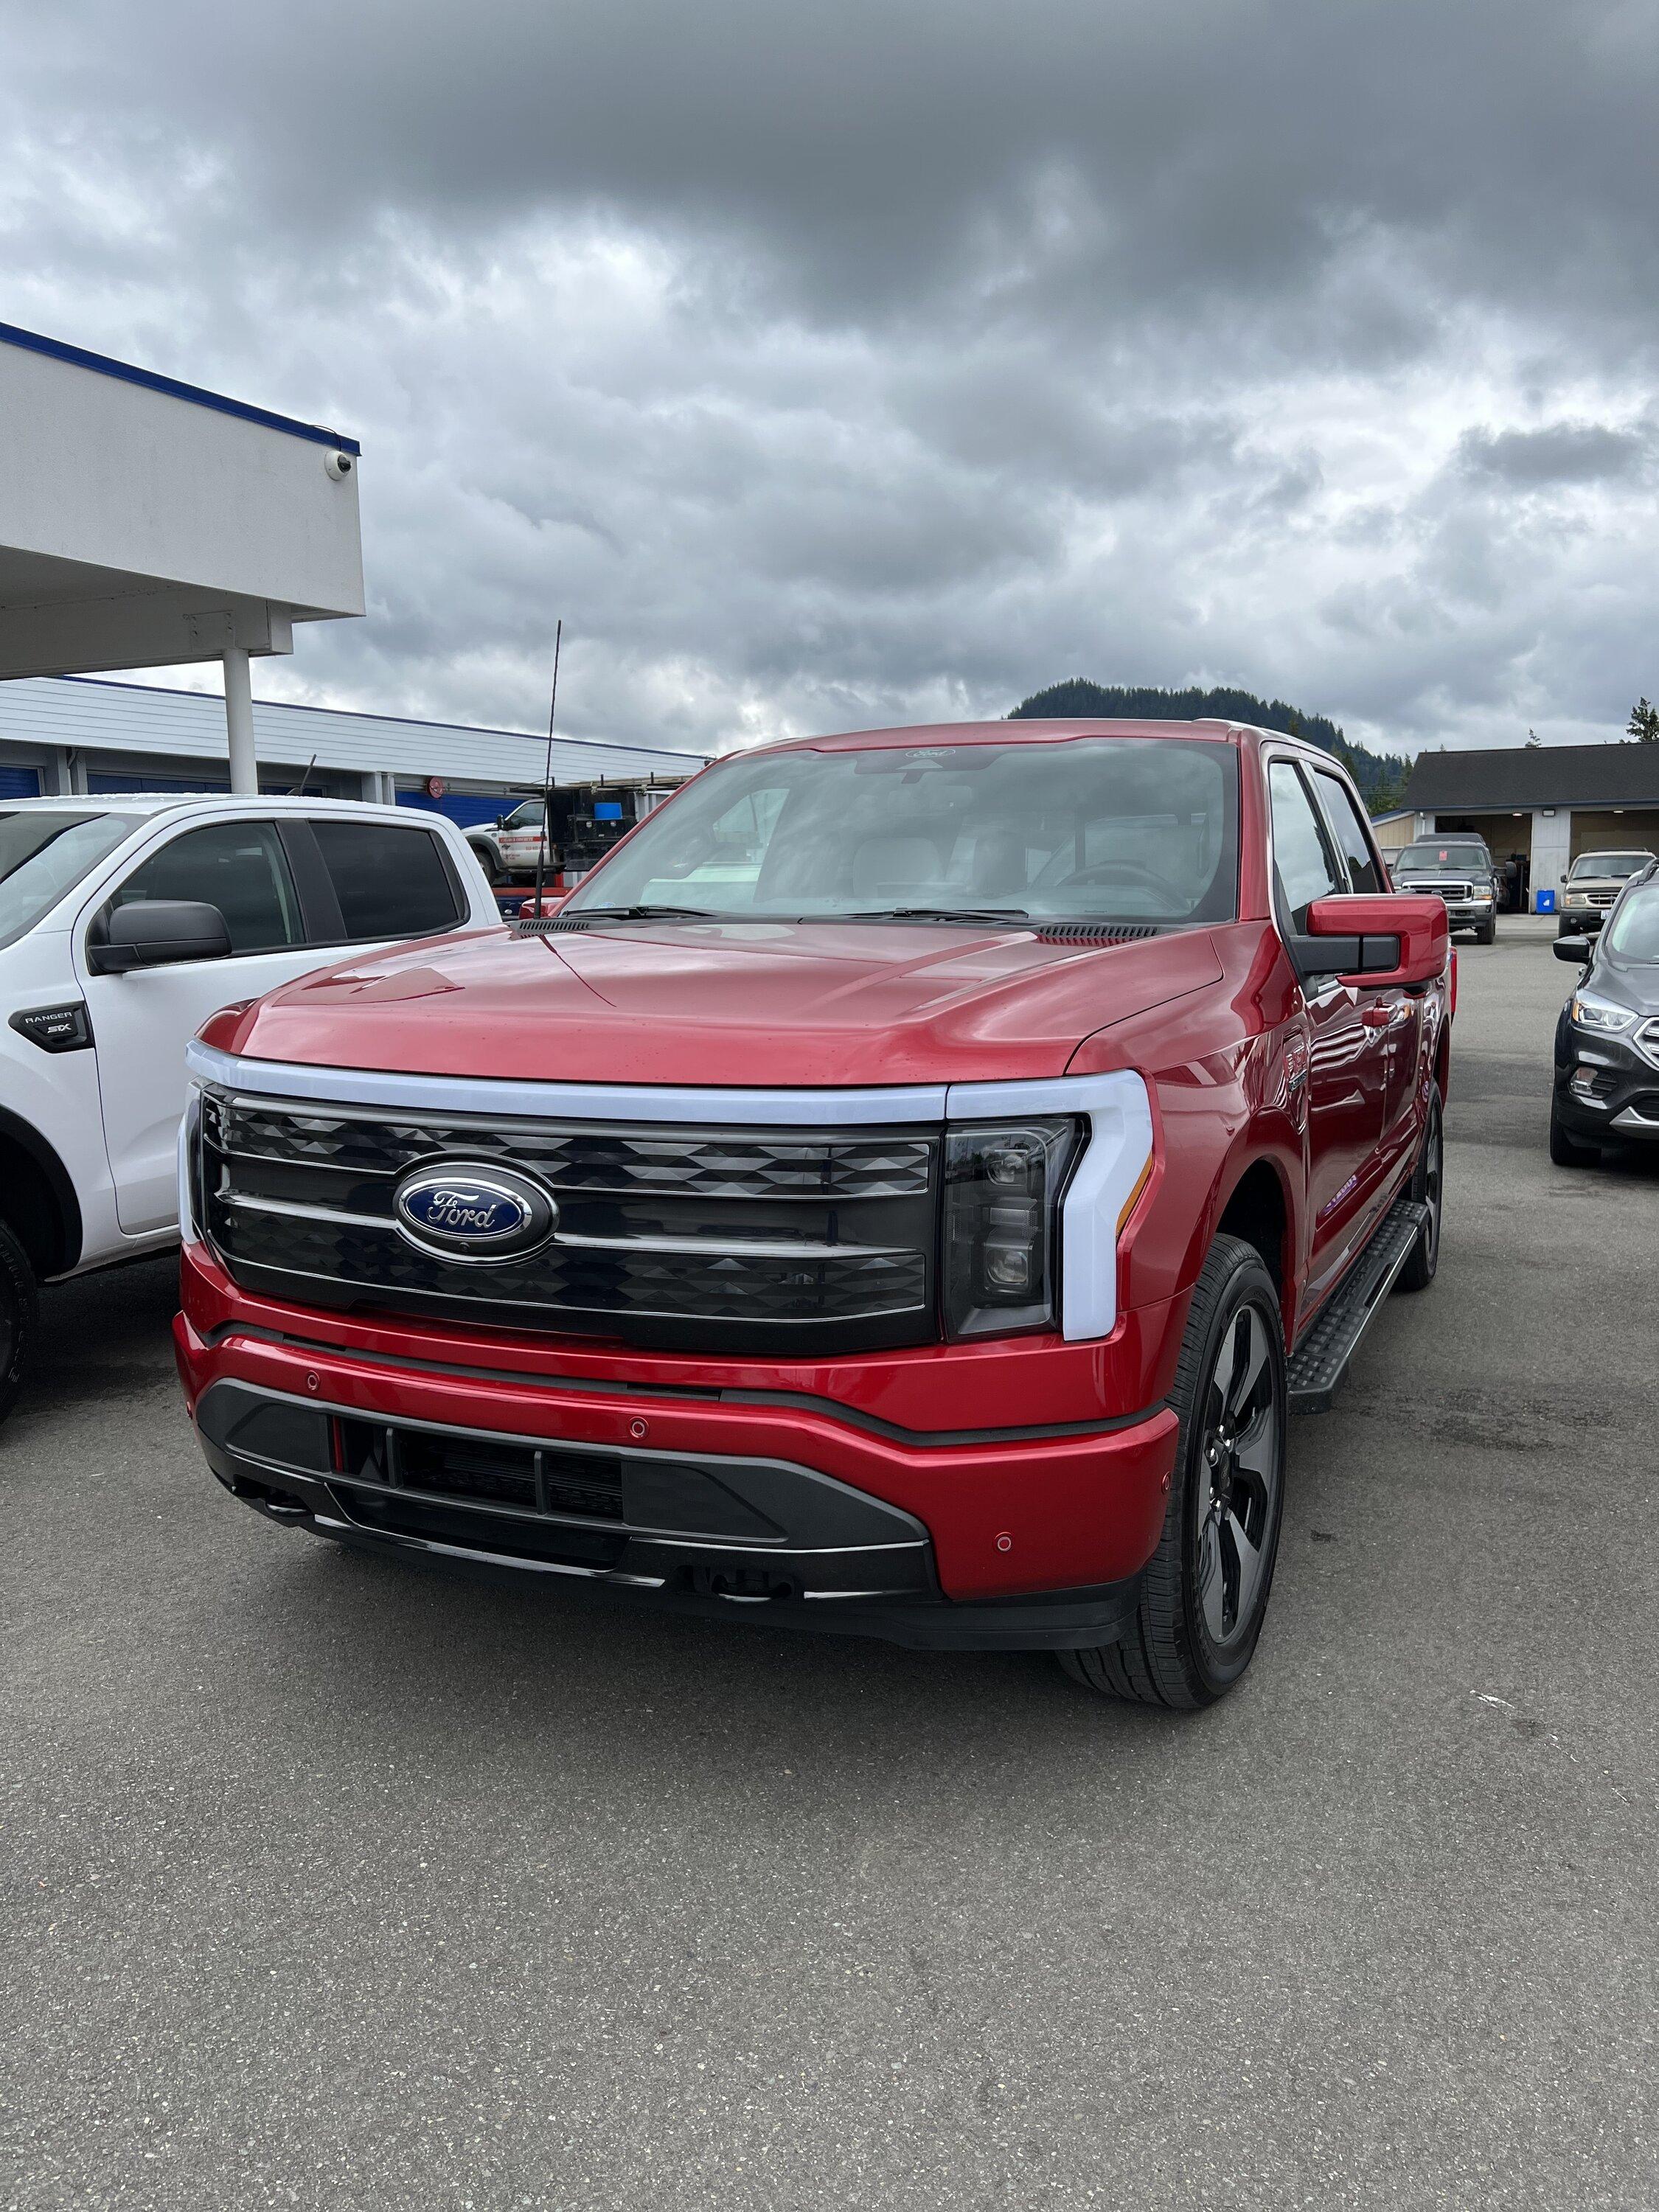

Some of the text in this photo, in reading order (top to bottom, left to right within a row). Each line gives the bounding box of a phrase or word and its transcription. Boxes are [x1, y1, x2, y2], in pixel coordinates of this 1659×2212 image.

[24, 1012, 72, 1023] RANGER
[47, 1023, 72, 1034] STX
[428, 1190, 497, 1228] Ford
